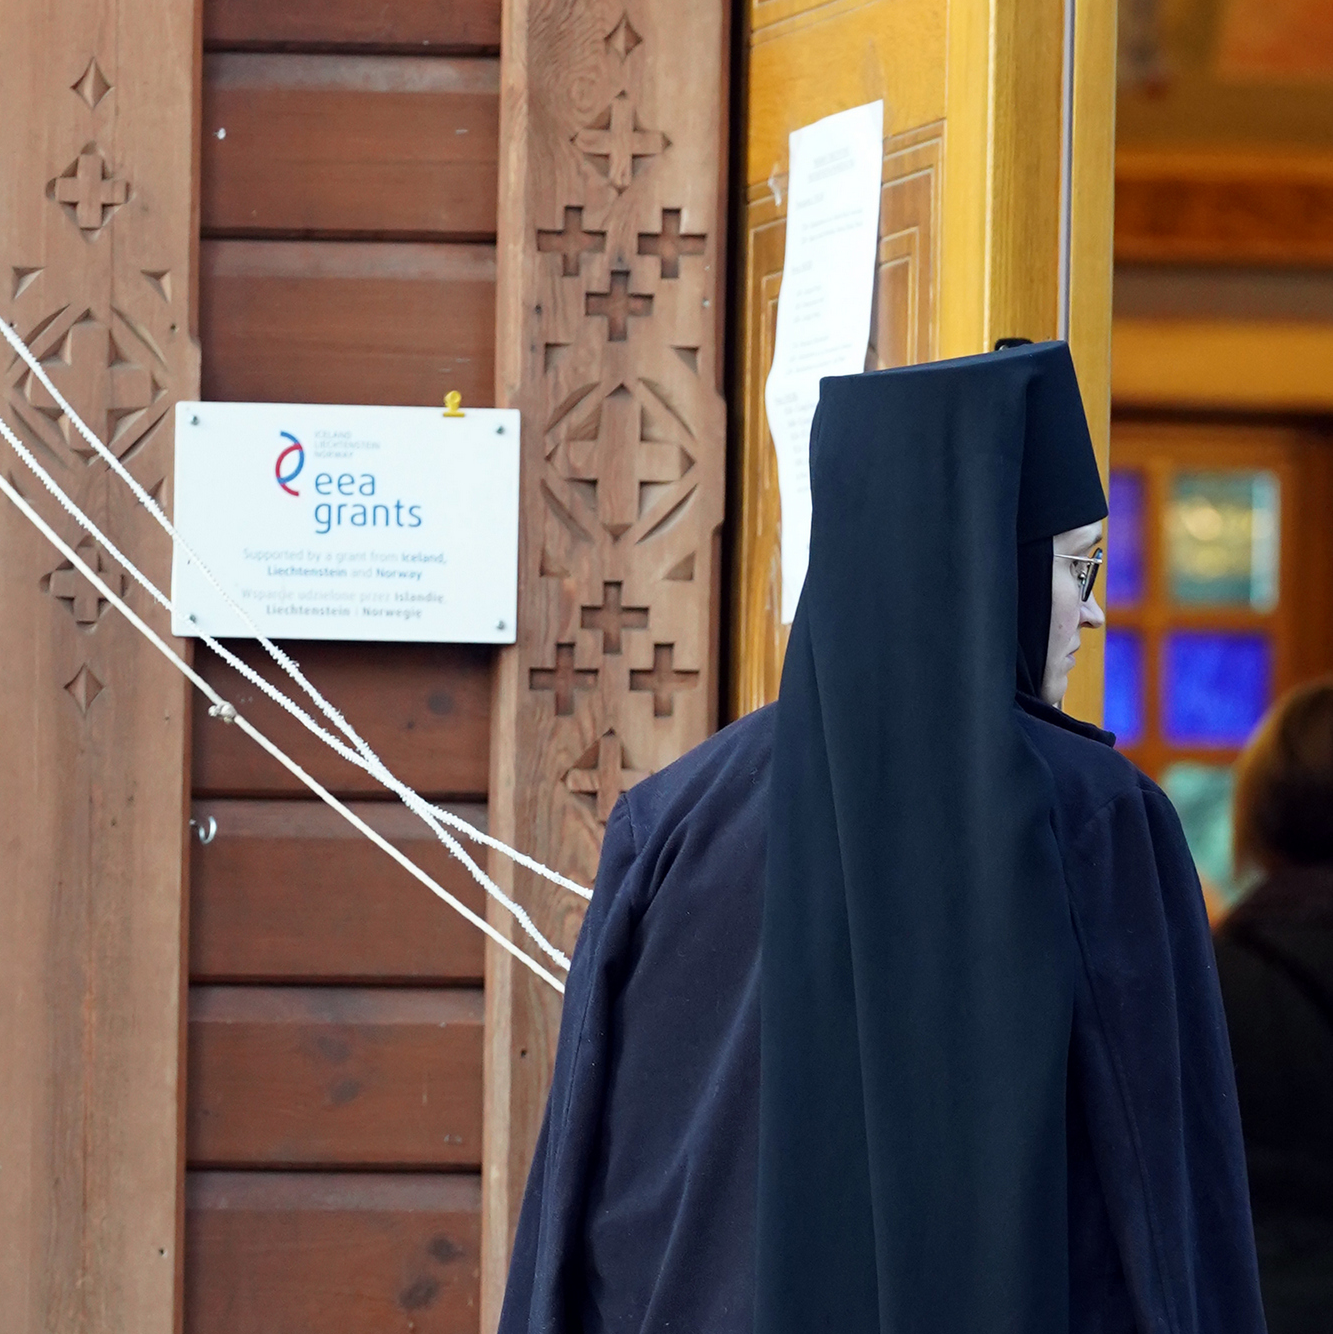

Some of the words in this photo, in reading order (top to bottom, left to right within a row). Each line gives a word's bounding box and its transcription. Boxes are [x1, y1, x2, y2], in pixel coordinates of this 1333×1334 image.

[314, 450, 353, 459] NORWAY
[314, 472, 376, 496] eea
[314, 499, 422, 534] grants
[243, 548, 304, 563] Supported
[307, 549, 321, 563] by
[325, 552, 333, 561] a
[336, 550, 366, 564] grant
[371, 551, 398, 562] from
[401, 551, 447, 565] Iceland,
[267, 565, 348, 578] Liechtenstein
[351, 566, 373, 578] and
[376, 568, 423, 582] Norway
[242, 588, 294, 602] Wsparcie
[298, 590, 356, 602] udzielone
[359, 593, 390, 605] przez
[266, 604, 350, 616] Liechtenstein
